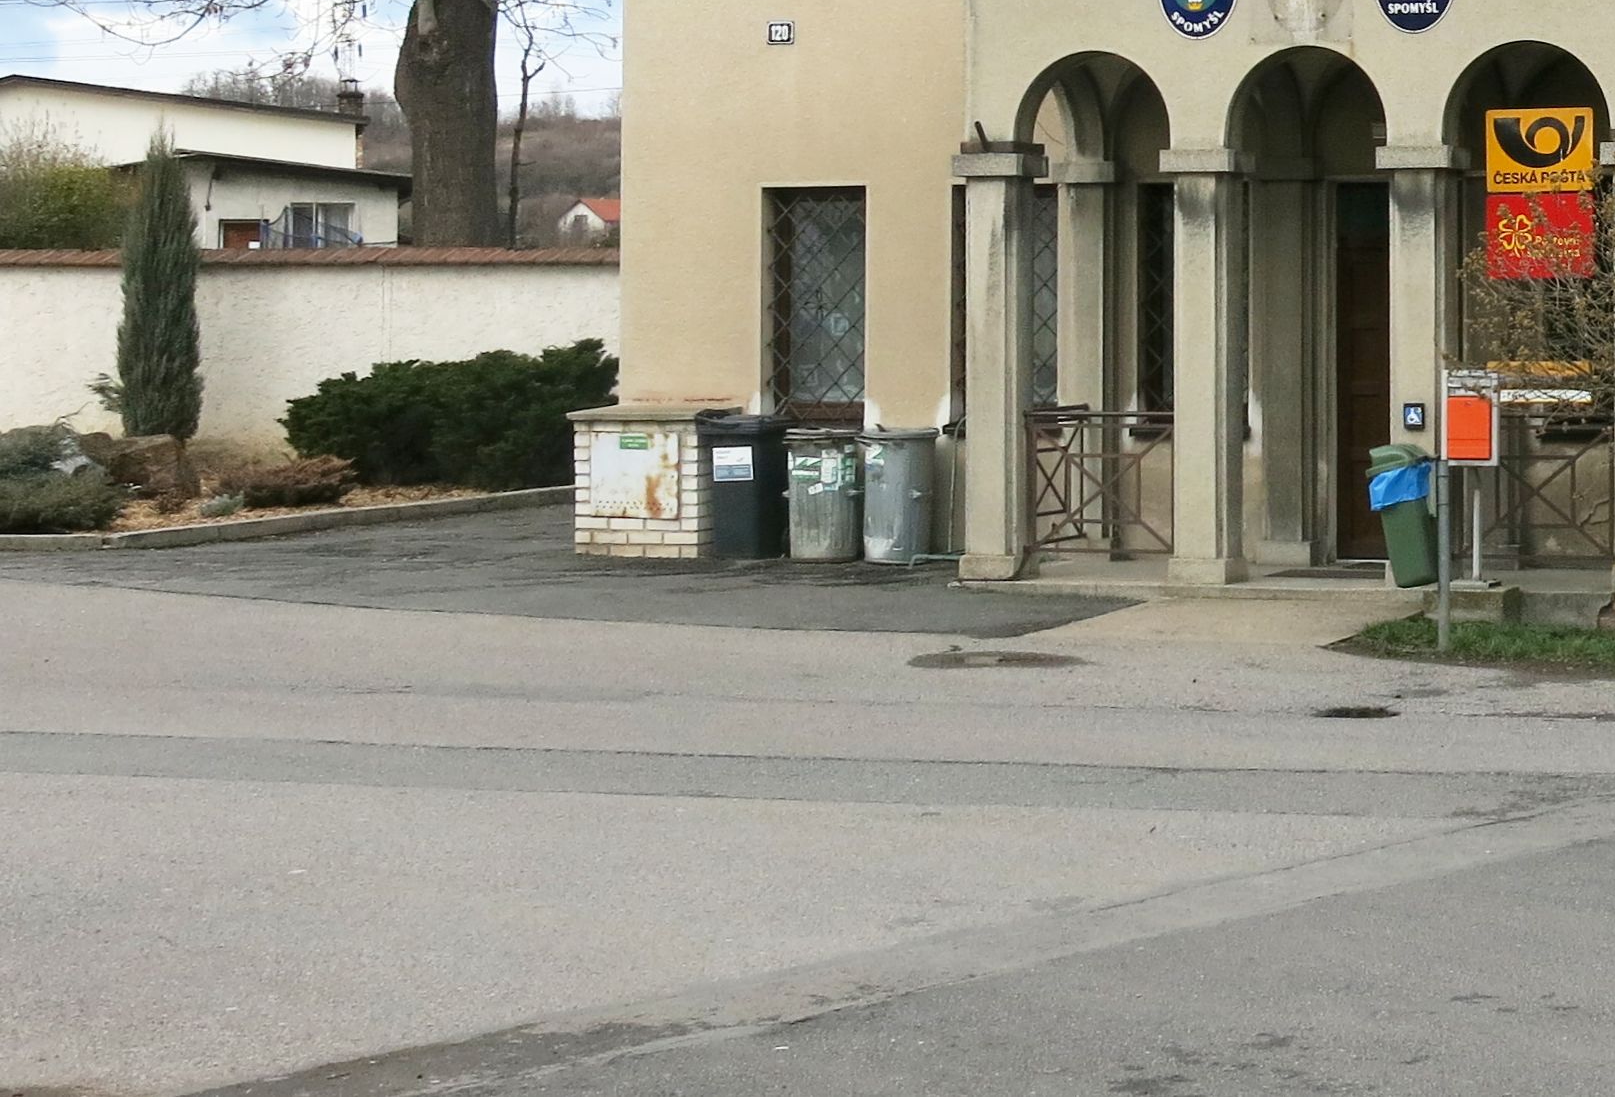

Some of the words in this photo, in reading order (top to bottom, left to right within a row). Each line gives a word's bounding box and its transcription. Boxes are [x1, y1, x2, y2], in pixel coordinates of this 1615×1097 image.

[1387, 0, 1440, 15] SPOMYŠL
[1171, 10, 1225, 33] SPOMYŠL
[770, 25, 789, 41] 120
[1493, 170, 1538, 185] ČESKÁ
